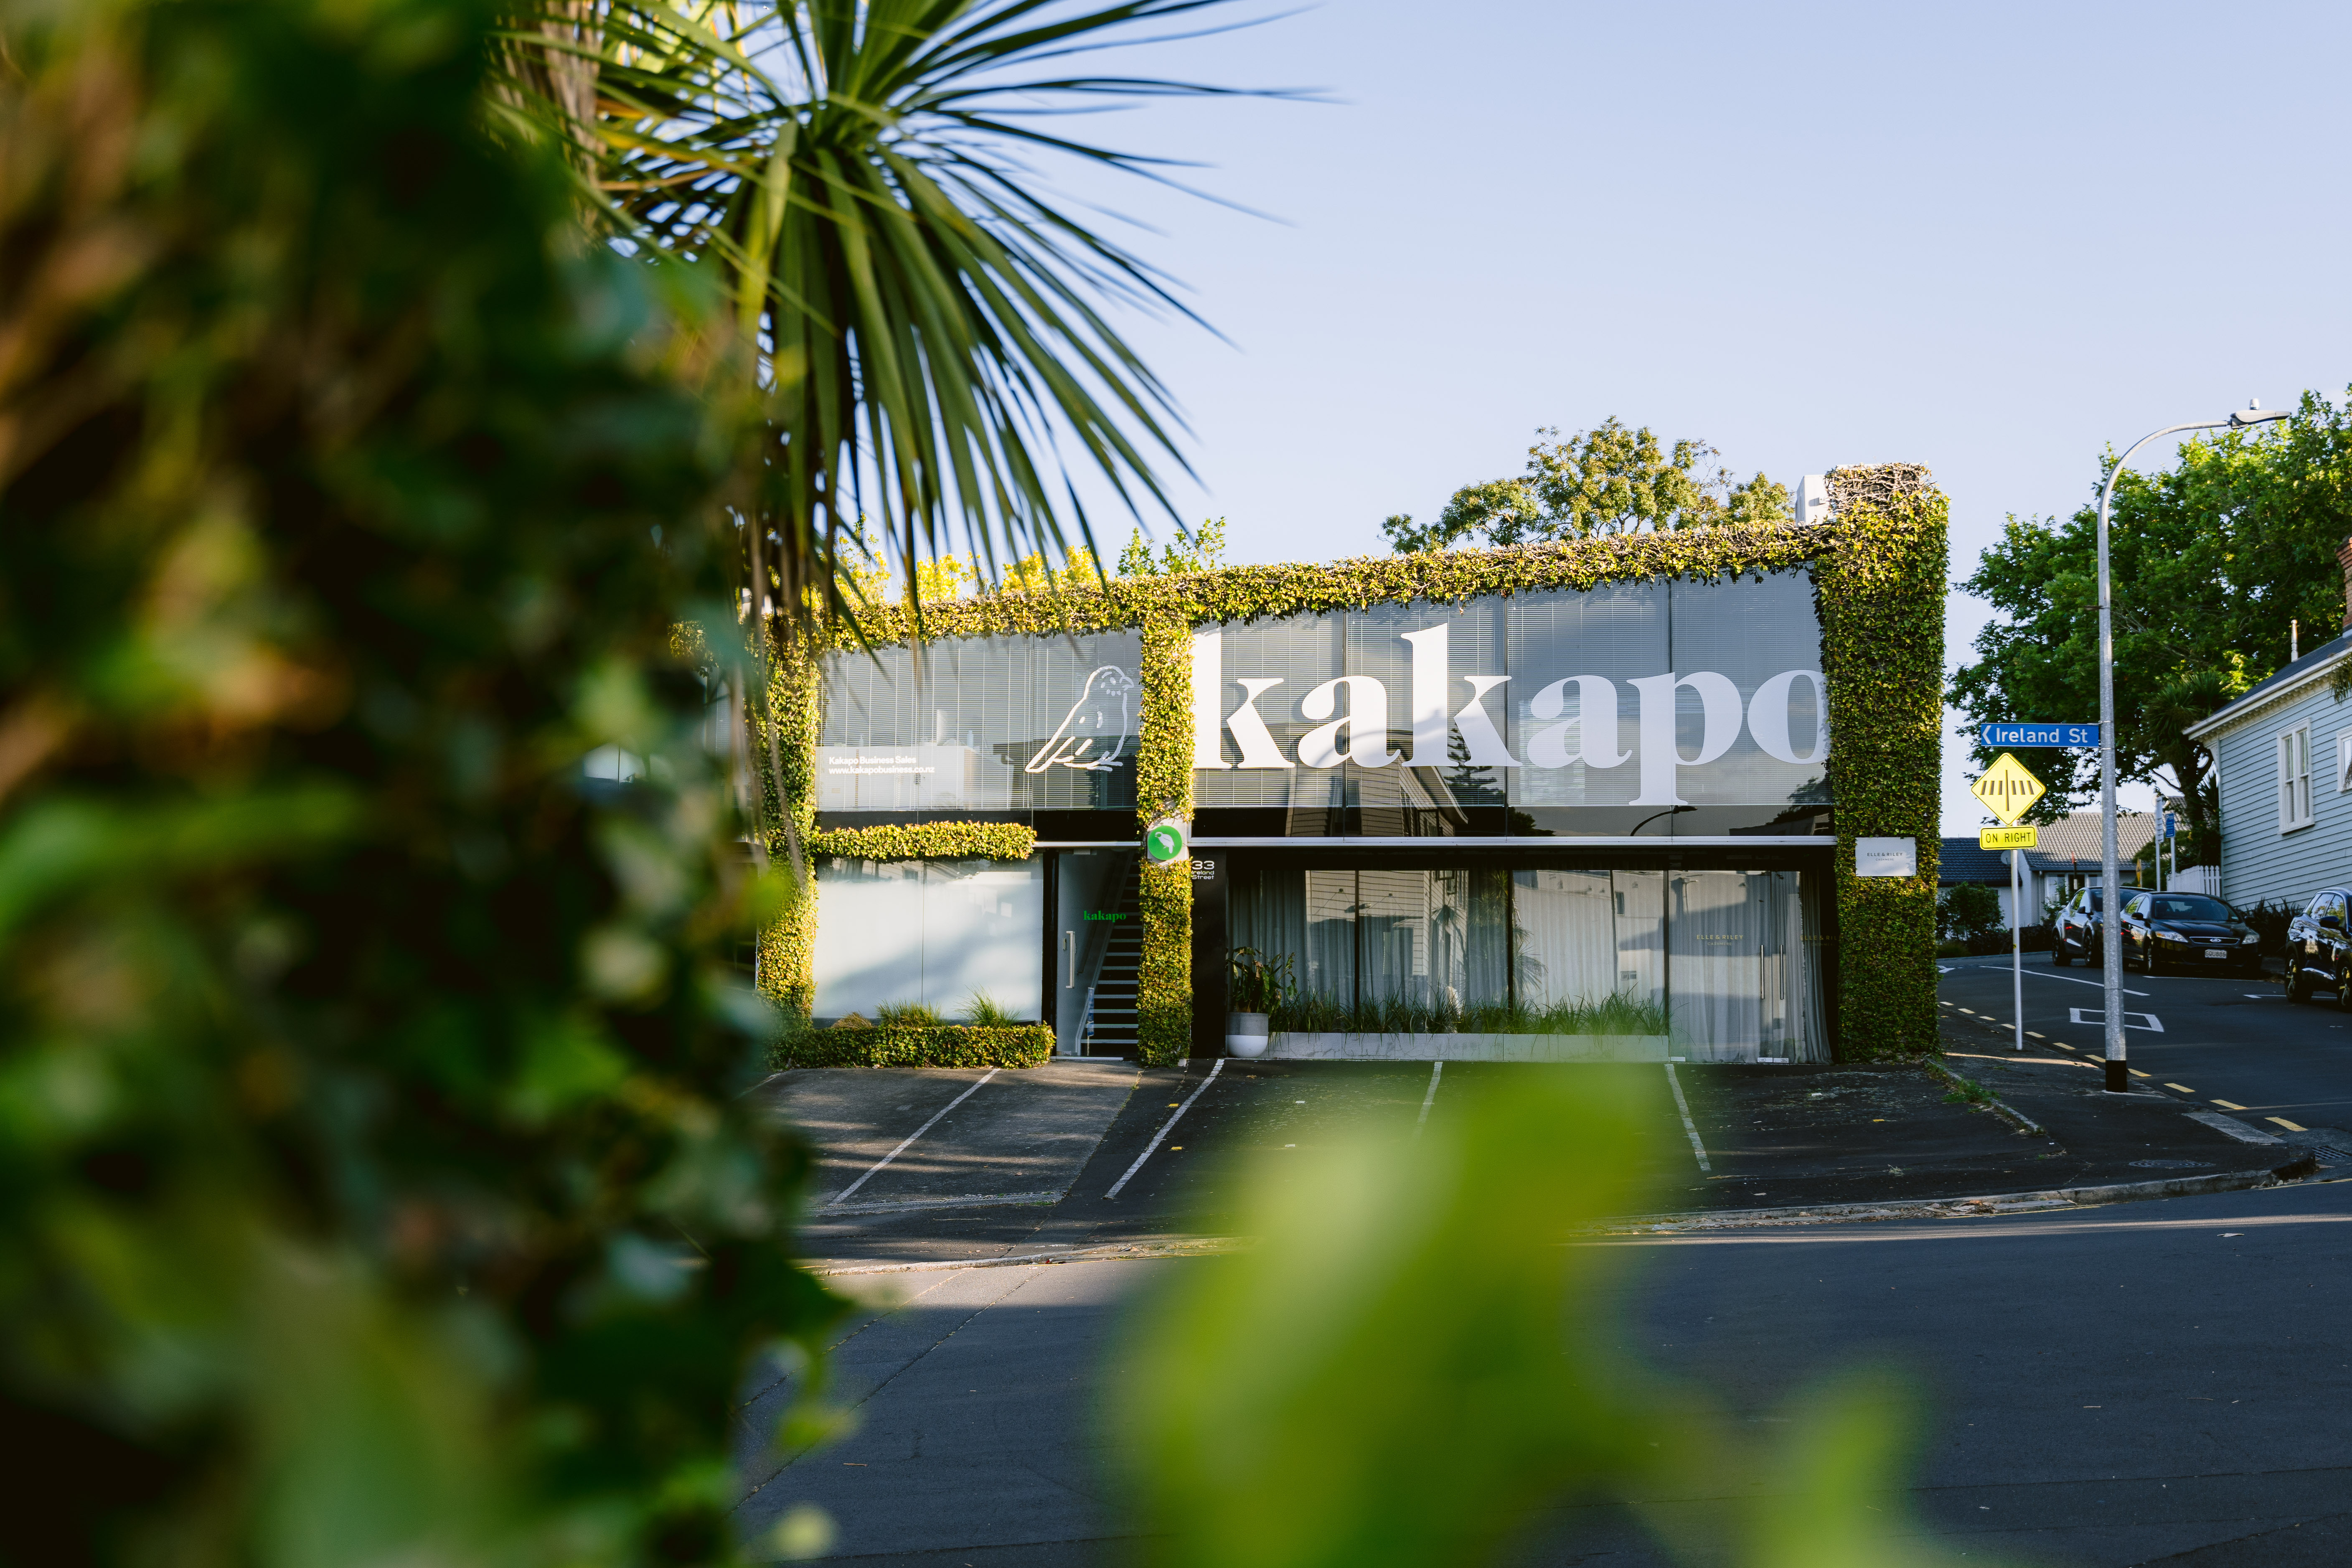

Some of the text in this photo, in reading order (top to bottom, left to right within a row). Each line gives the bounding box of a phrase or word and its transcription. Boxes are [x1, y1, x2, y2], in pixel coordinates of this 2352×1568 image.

[1192, 623, 1831, 806] kakapo
[1996, 727, 2088, 743] Ireland St
[829, 755, 917, 766] Kakapo Business Sales
[828, 765, 935, 775] www.kakapobusiness.co.nz
[1986, 832, 2031, 843] ON RIGHT
[1192, 860, 1214, 869] 33
[1084, 910, 1127, 923] kakapo
